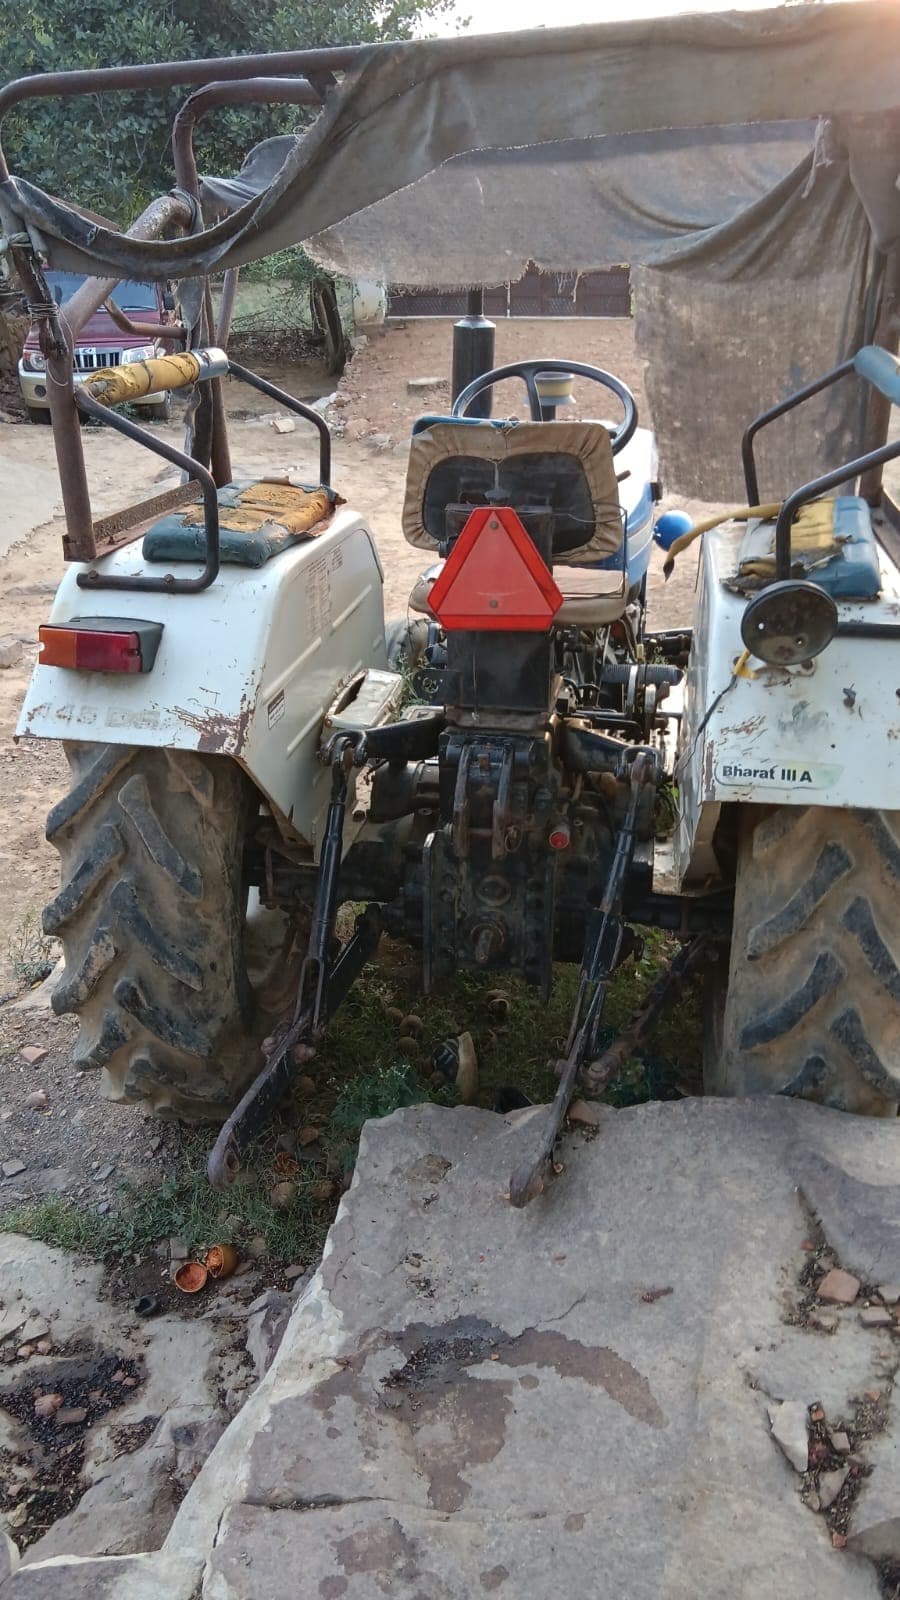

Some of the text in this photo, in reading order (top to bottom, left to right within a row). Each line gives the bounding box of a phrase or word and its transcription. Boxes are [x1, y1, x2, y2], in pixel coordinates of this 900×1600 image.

[722, 765, 812, 783] Bharat III A
